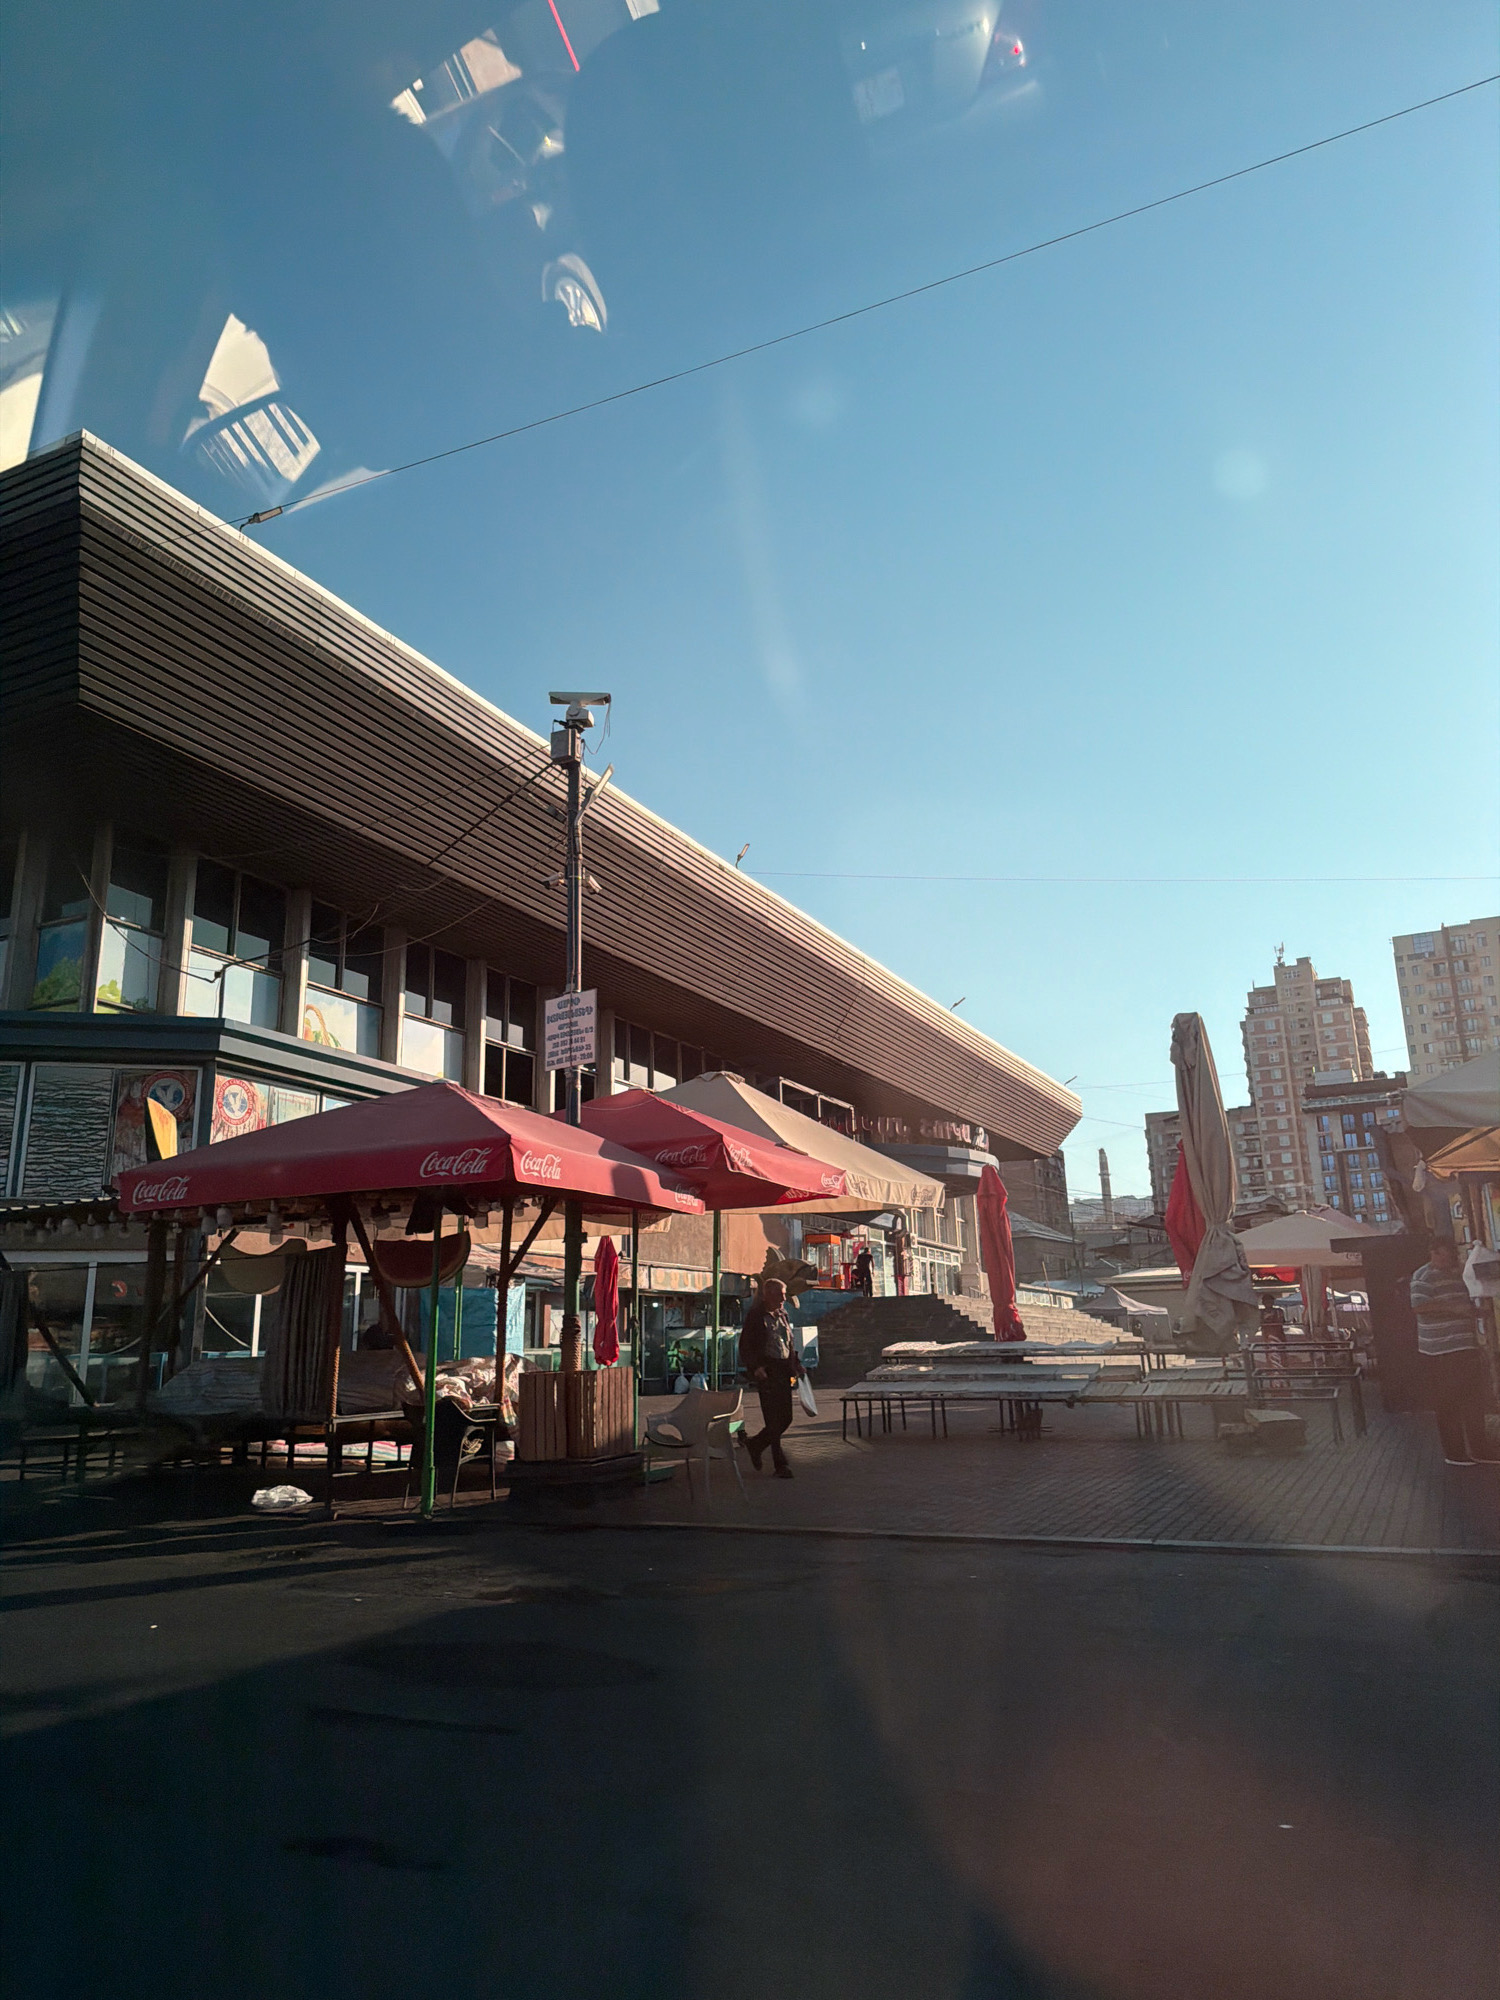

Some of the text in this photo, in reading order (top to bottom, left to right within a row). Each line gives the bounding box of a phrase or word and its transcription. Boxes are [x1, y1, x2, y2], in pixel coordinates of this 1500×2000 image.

[420, 1147, 494, 1179] Coca-Cola
[520, 1150, 562, 1180] Coca-Cola
[133, 1176, 191, 1206] Coca-Cola
